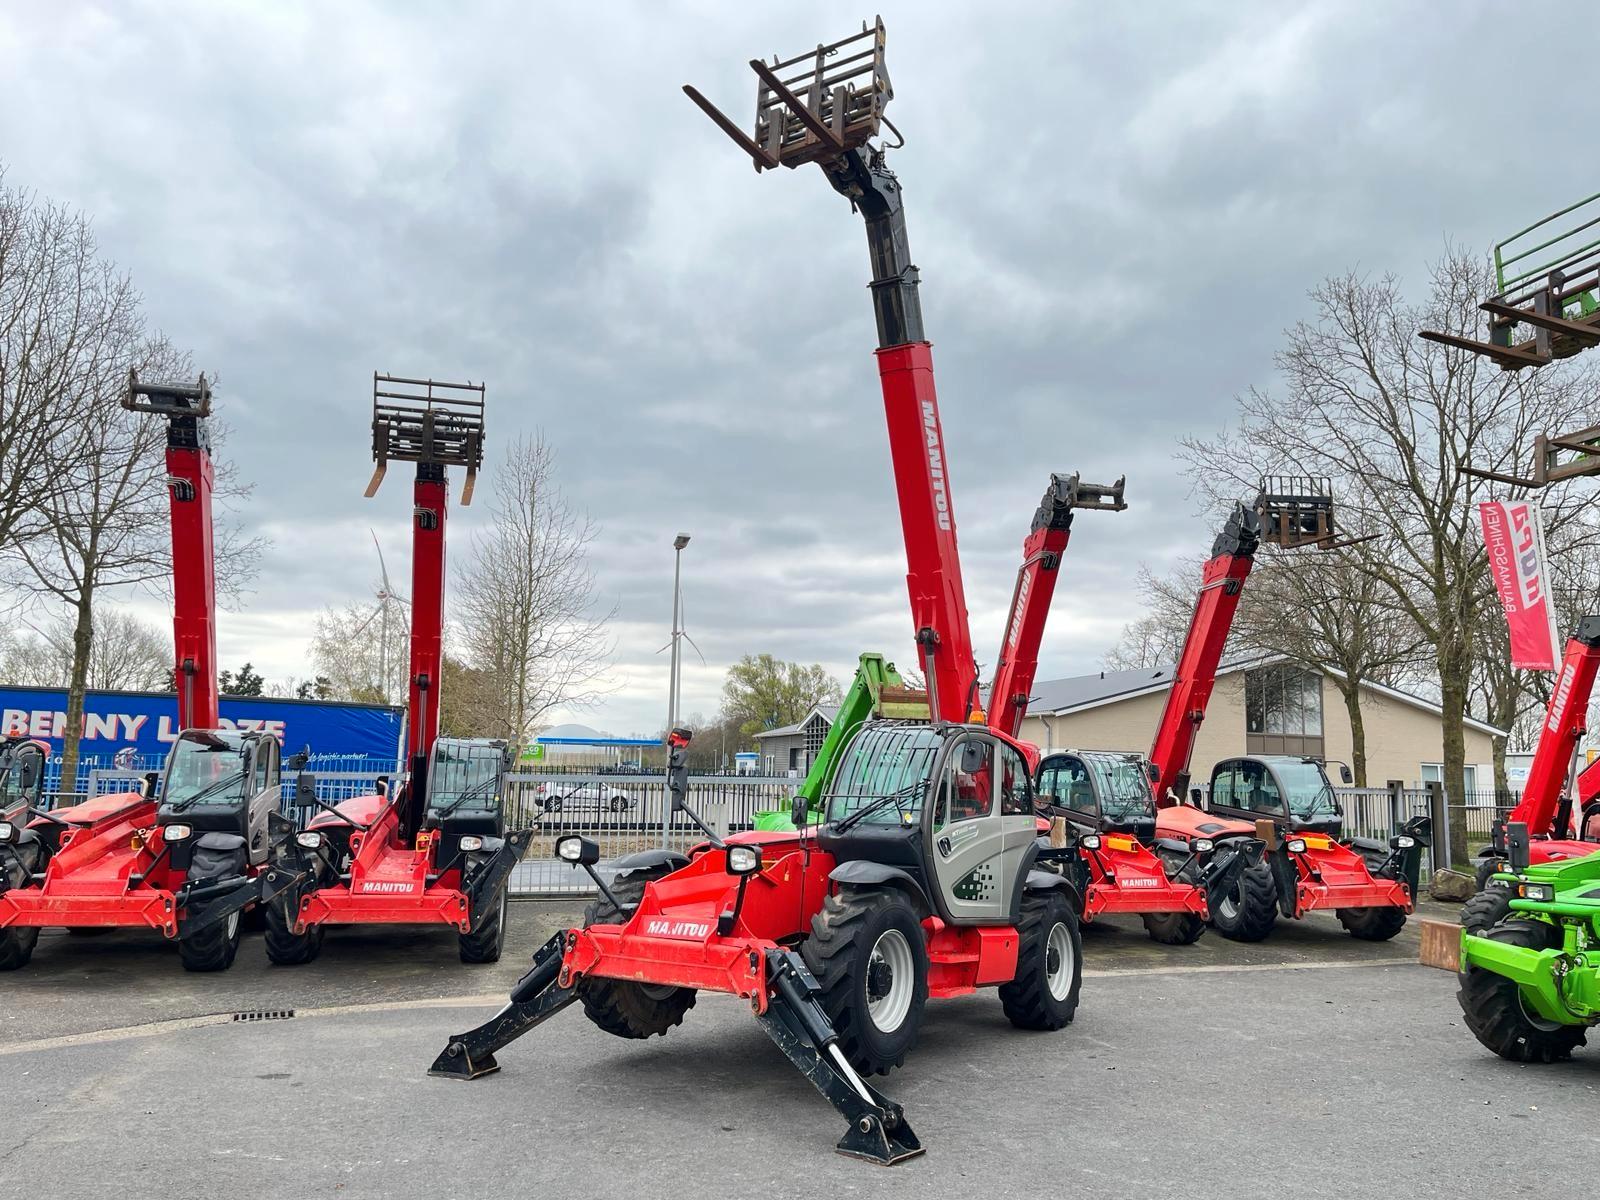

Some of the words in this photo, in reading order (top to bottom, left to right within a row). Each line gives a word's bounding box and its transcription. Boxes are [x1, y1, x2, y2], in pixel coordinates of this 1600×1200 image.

[922, 400, 952, 531] MANITOU
[1008, 567, 1031, 648] MANITOU
[1547, 663, 1576, 733] MANITOU
[157, 715, 287, 746] LZE
[363, 882, 414, 893] MANITOU
[1121, 878, 1158, 888] MANITOU
